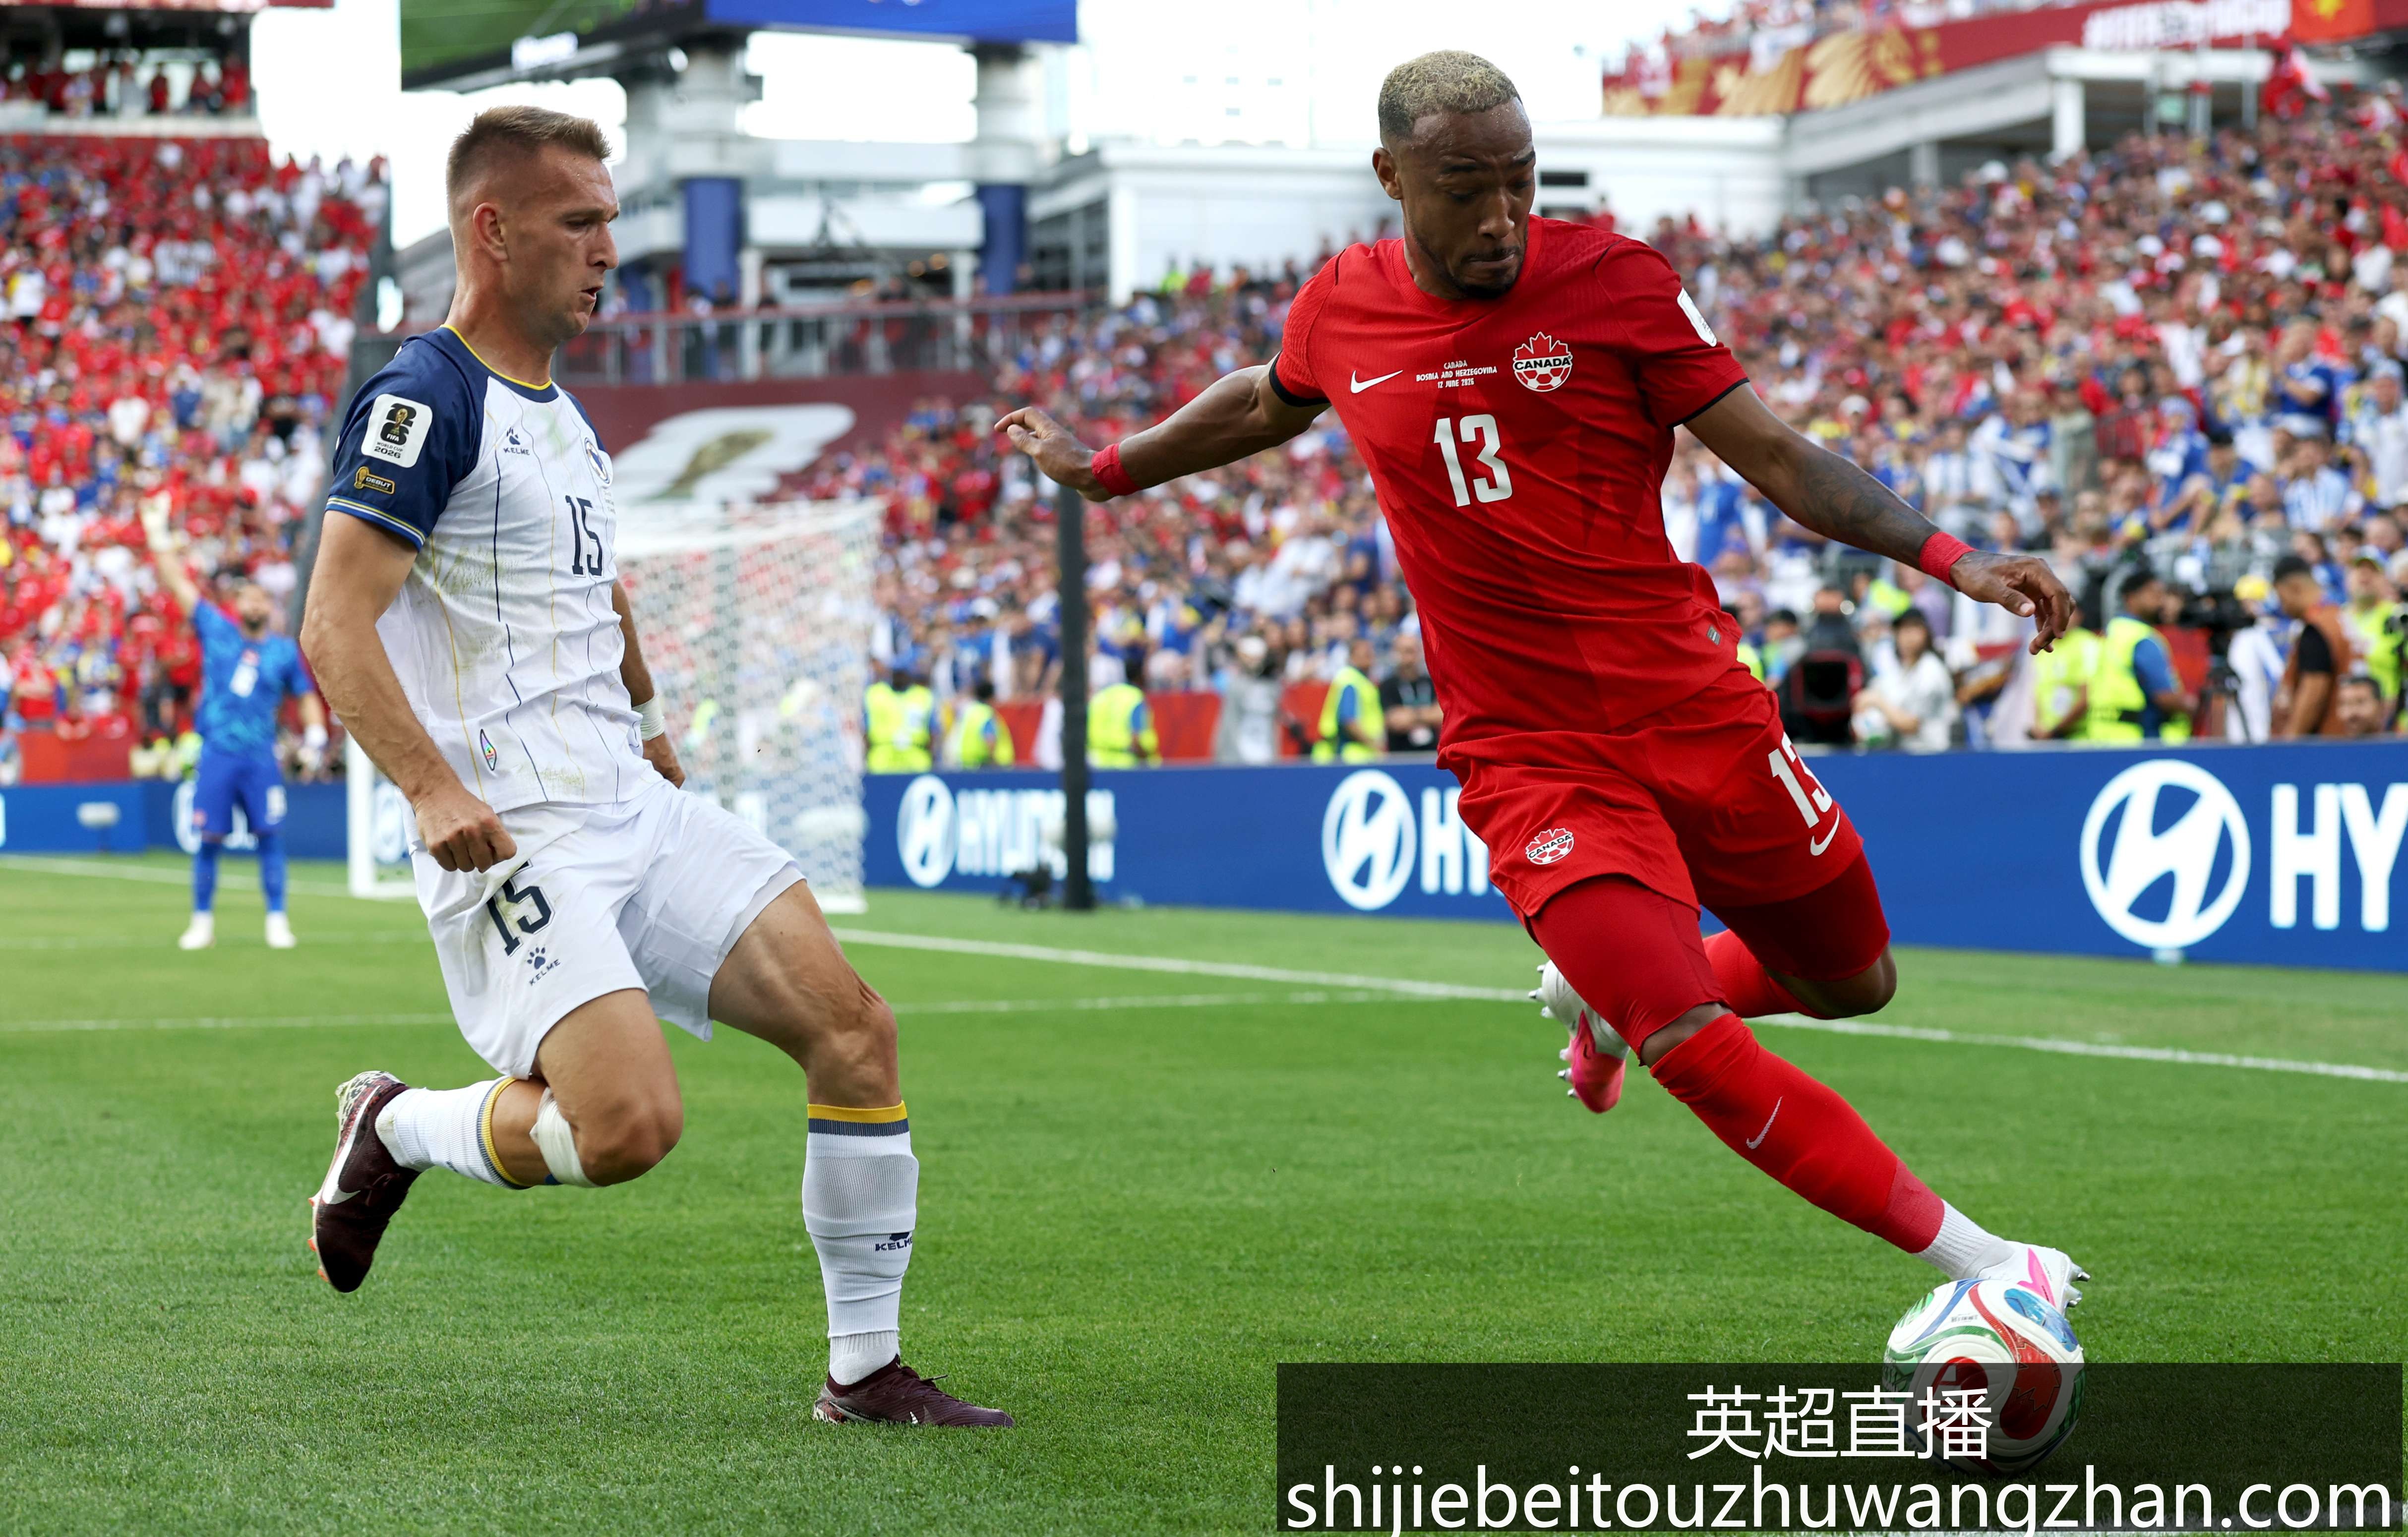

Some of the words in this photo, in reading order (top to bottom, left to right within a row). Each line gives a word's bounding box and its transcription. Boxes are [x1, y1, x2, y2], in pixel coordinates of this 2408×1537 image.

[1444, 360, 1468, 369] CANADA
[1514, 357, 1571, 370] CANADA
[1416, 372, 1439, 382] BOSNIA
[1441, 370, 1453, 379] AND
[1455, 366, 1497, 378] HERZEGOVINA
[1461, 377, 1474, 387] 2026
[386, 433, 399, 442] FIFA
[374, 446, 401, 459] 2026
[1434, 414, 1513, 507] 13
[365, 476, 392, 488] DEBUT
[565, 495, 603, 577] 15
[1768, 731, 1833, 828] 13
[1529, 835, 1571, 858] CANADA
[486, 860, 554, 956] 15
[529, 959, 561, 986] KELME
